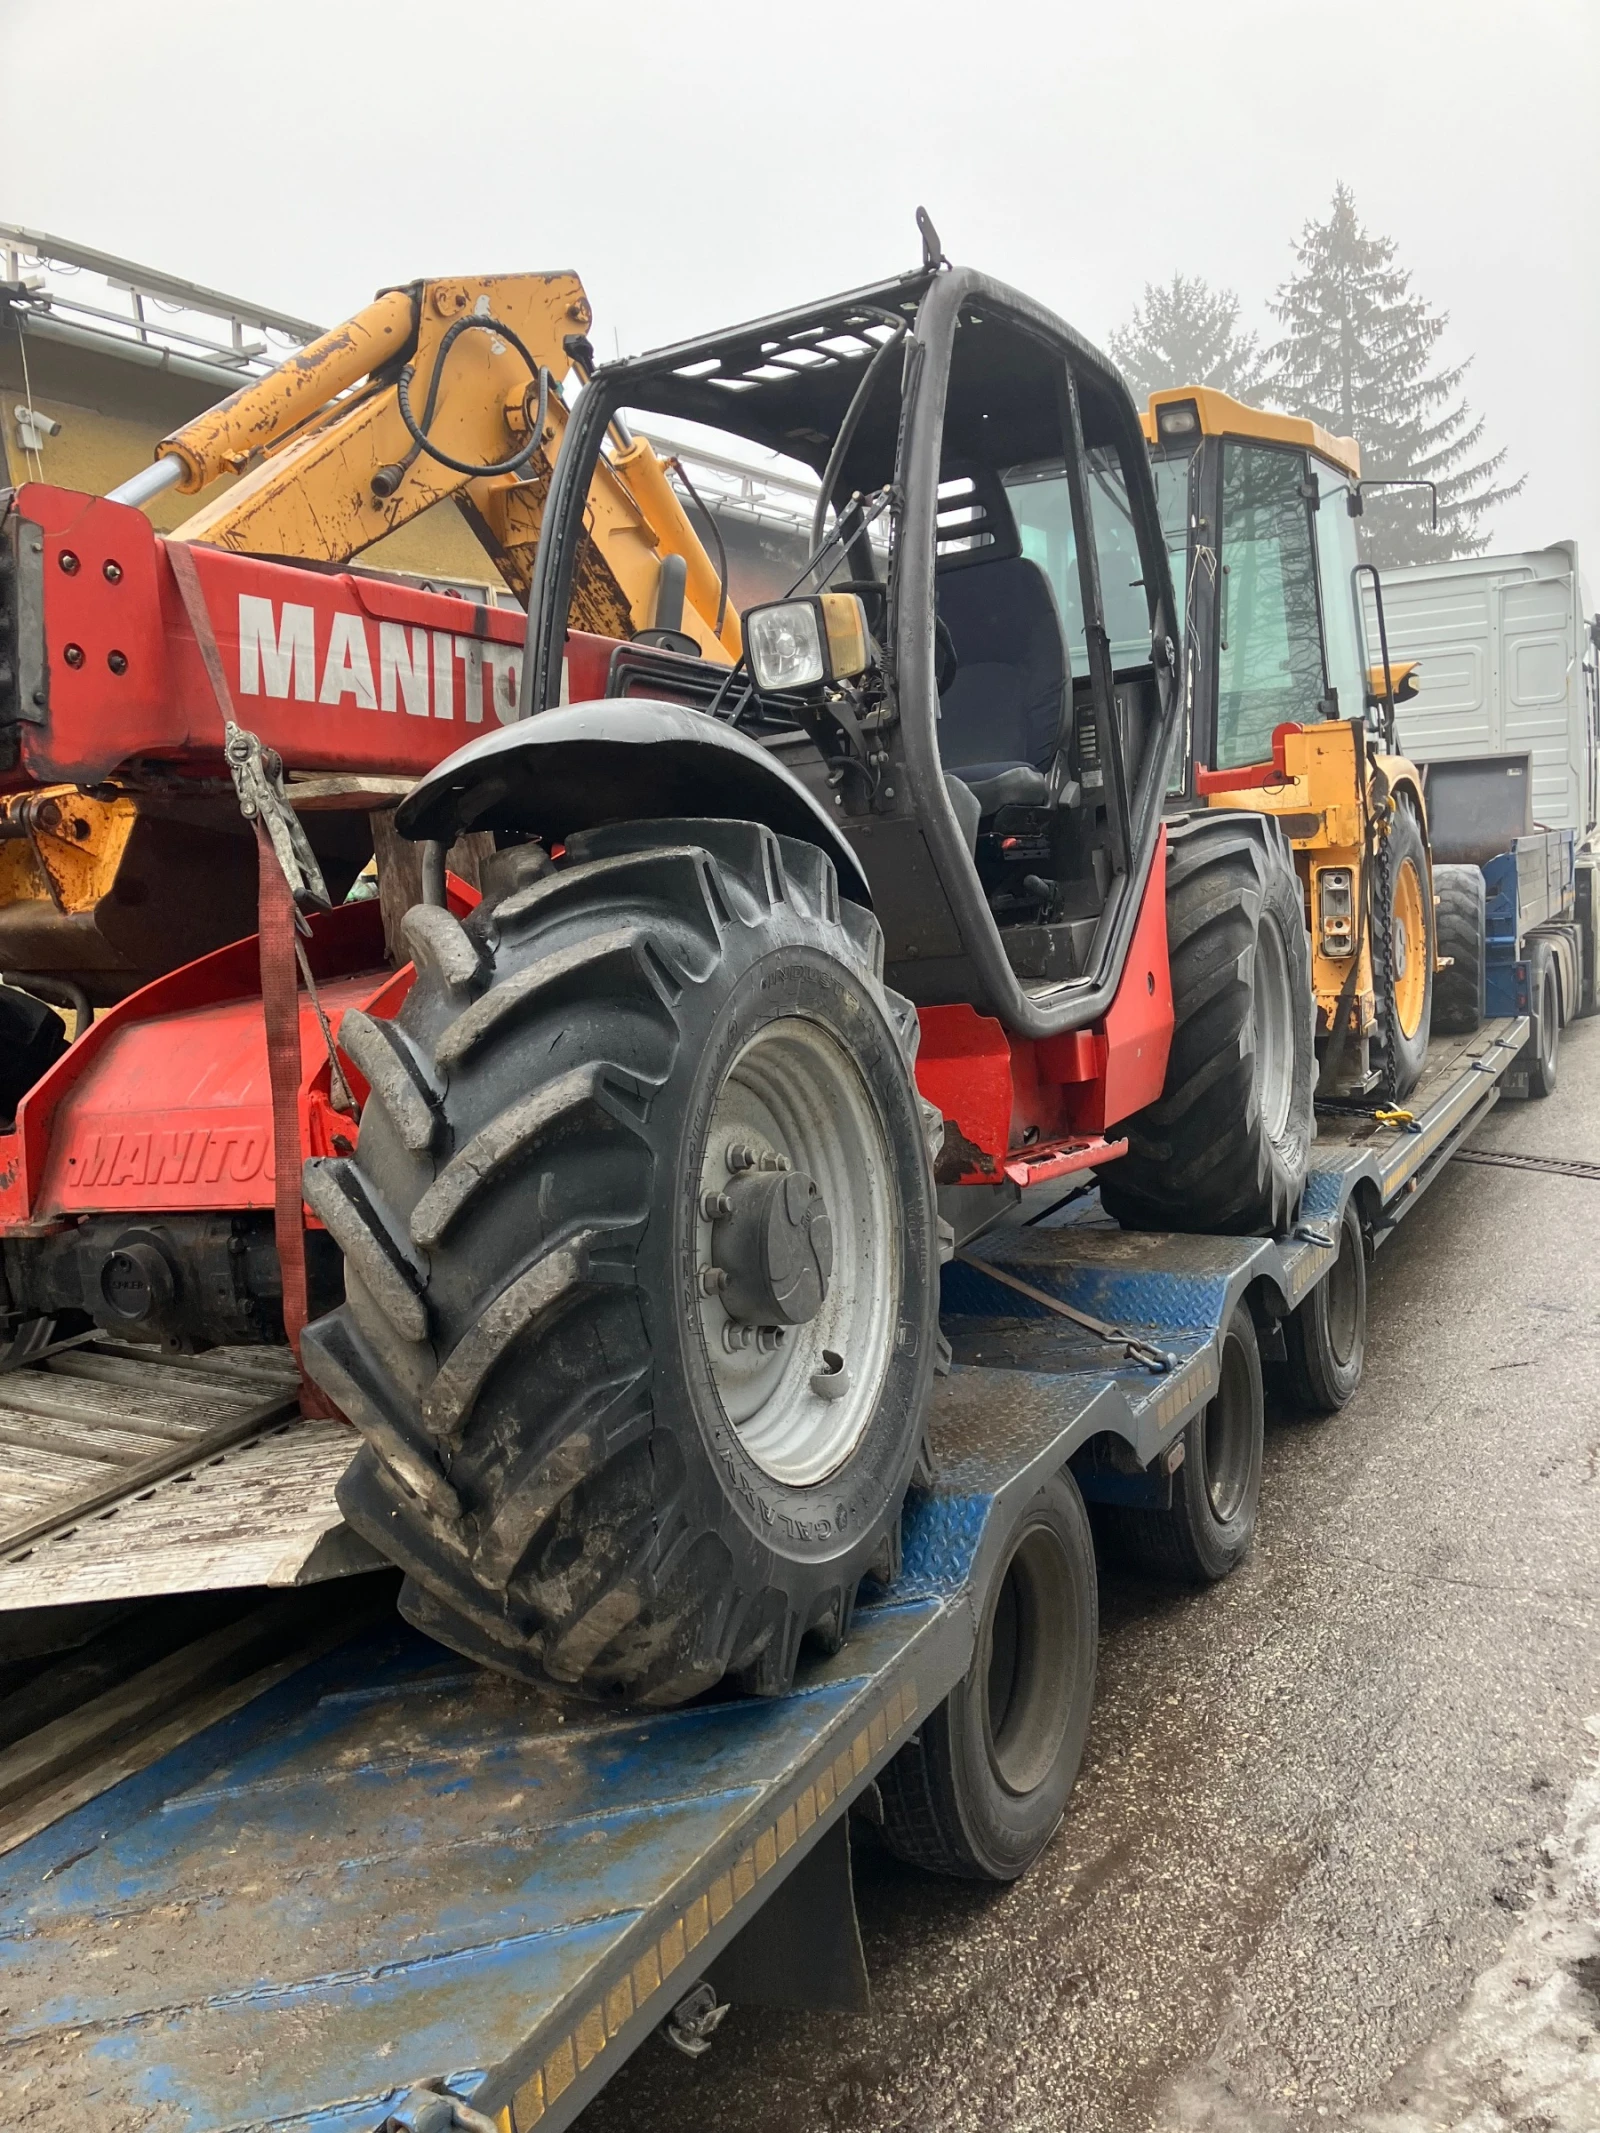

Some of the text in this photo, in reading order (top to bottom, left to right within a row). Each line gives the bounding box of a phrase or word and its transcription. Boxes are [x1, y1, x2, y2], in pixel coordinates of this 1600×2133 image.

[238, 593, 570, 727] MANITO
[69, 1125, 276, 1188] MANITO
[717, 1446, 834, 1543] GALAXY
